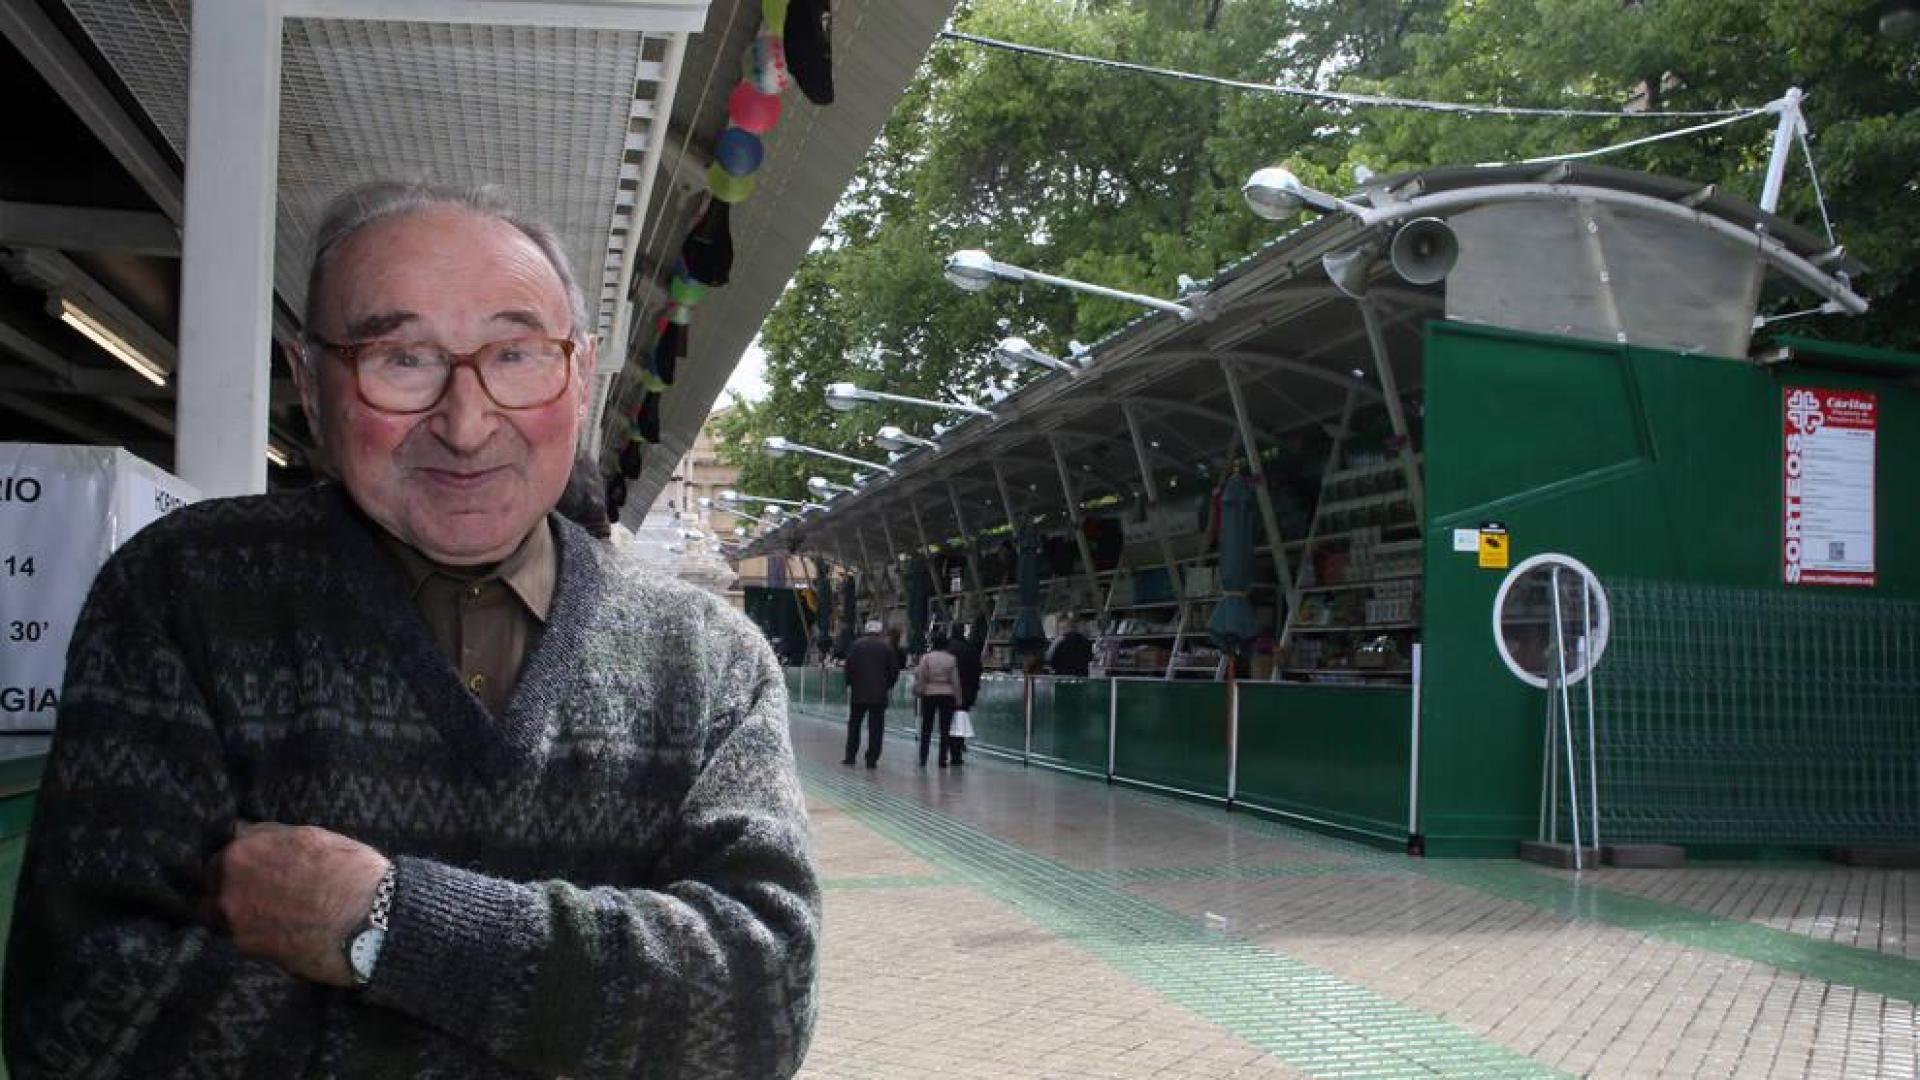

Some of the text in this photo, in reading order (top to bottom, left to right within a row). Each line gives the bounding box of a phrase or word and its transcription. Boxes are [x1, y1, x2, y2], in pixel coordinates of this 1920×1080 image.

[0, 476, 42, 502] IO
[1786, 433, 1801, 584] SORTEOS
[4, 555, 35, 577] 14
